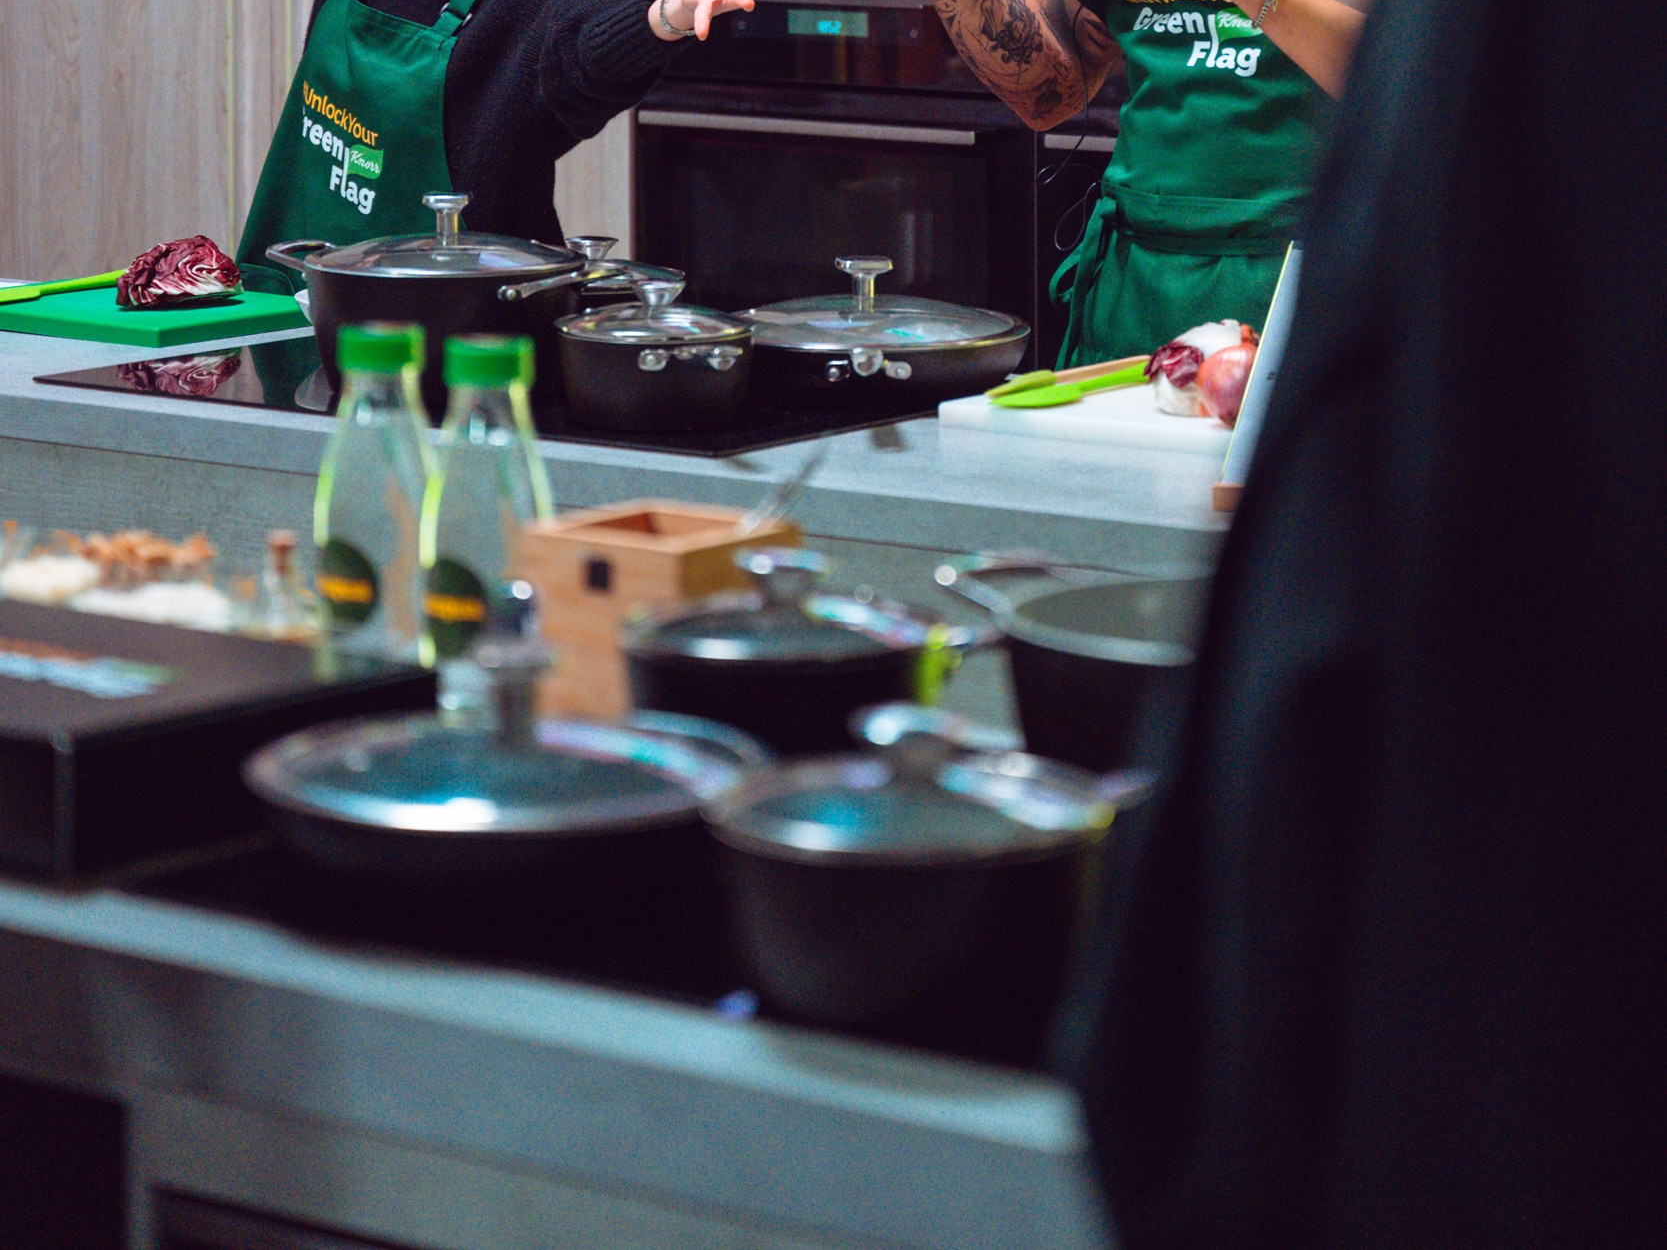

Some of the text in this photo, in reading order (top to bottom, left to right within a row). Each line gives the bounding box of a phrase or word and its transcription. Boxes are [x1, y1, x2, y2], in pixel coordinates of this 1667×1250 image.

[1133, 6, 1206, 34] Green
[1217, 11, 1253, 28] Kno
[1187, 14, 1261, 77] Flag
[302, 108, 344, 161] reen
[329, 146, 376, 215] Flag
[350, 150, 381, 174] Knorr
